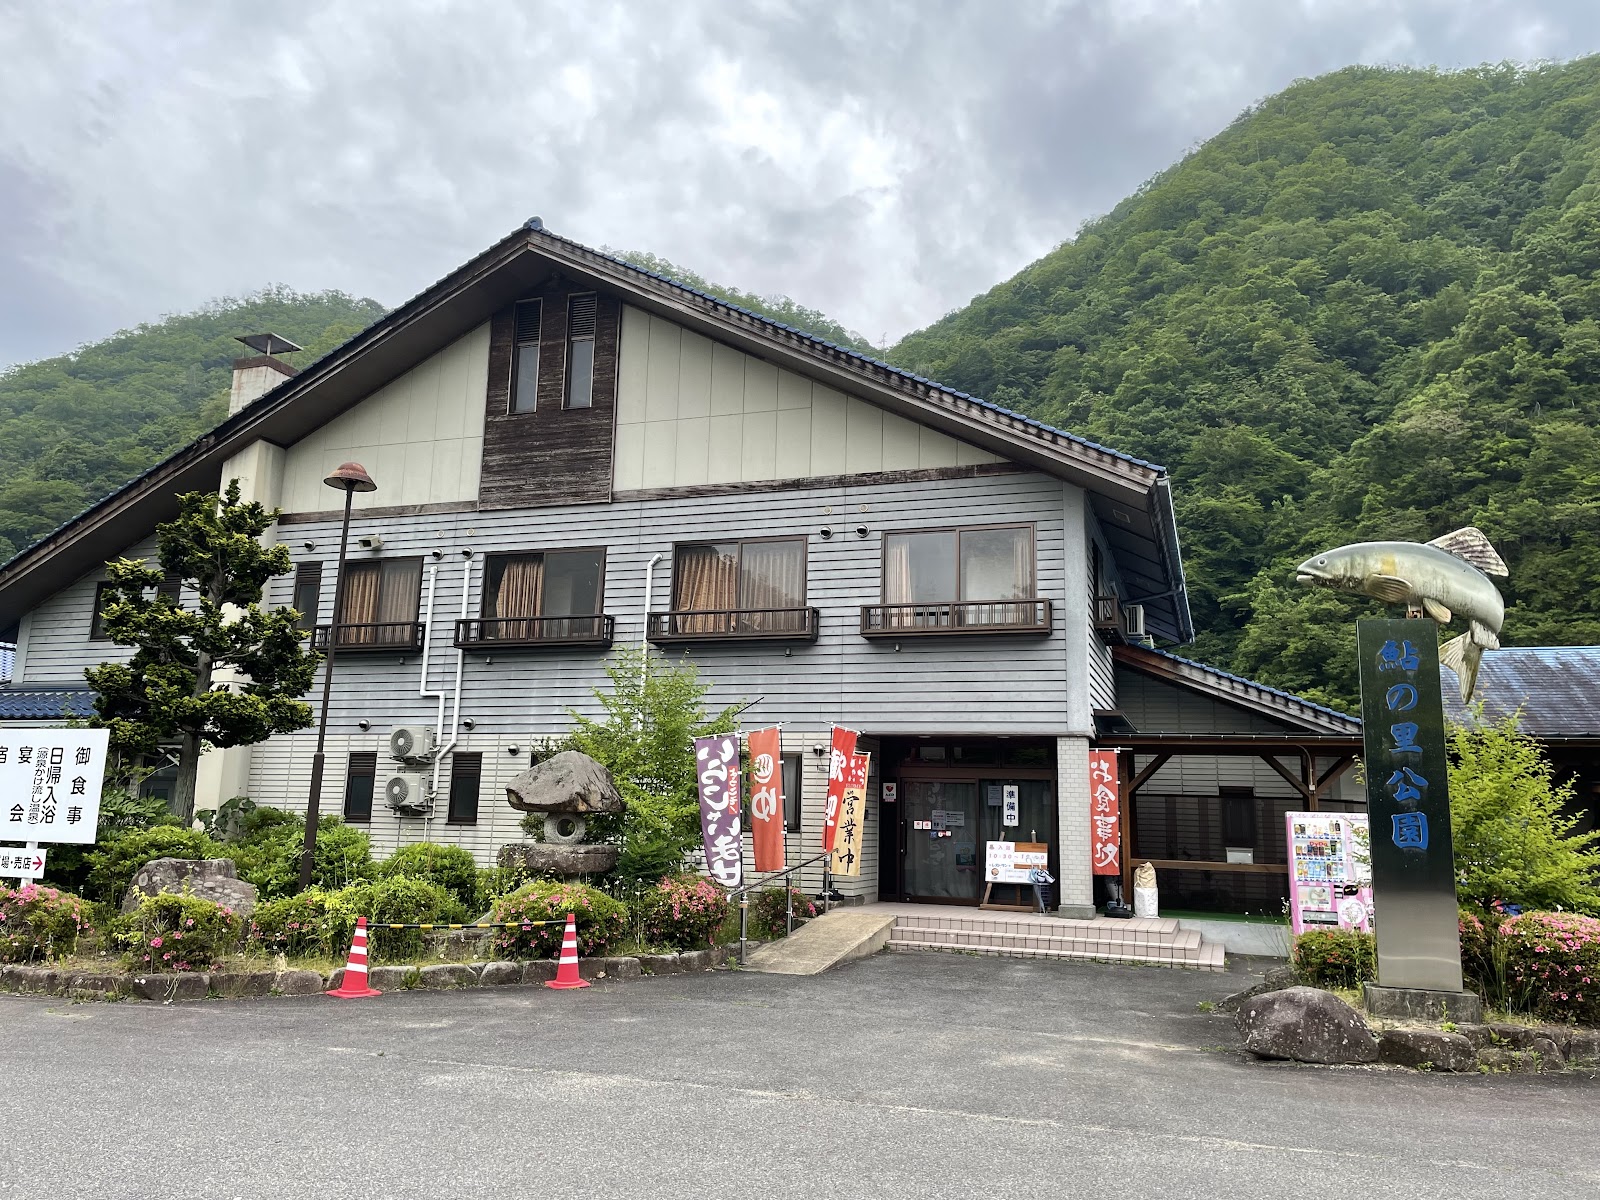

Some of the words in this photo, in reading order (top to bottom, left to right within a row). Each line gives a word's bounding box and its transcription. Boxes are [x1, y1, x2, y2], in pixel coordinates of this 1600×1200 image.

[10, 745, 33, 823] 宴会
[1378, 640, 1429, 850] 鮎の里公園
[39, 747, 64, 824] 日帰入浴
[67, 746, 91, 825] 御食事
[1006, 790, 1016, 823] 準備中
[0, 856, 32, 870] 場・売店
[838, 790, 860, 873] 営業中
